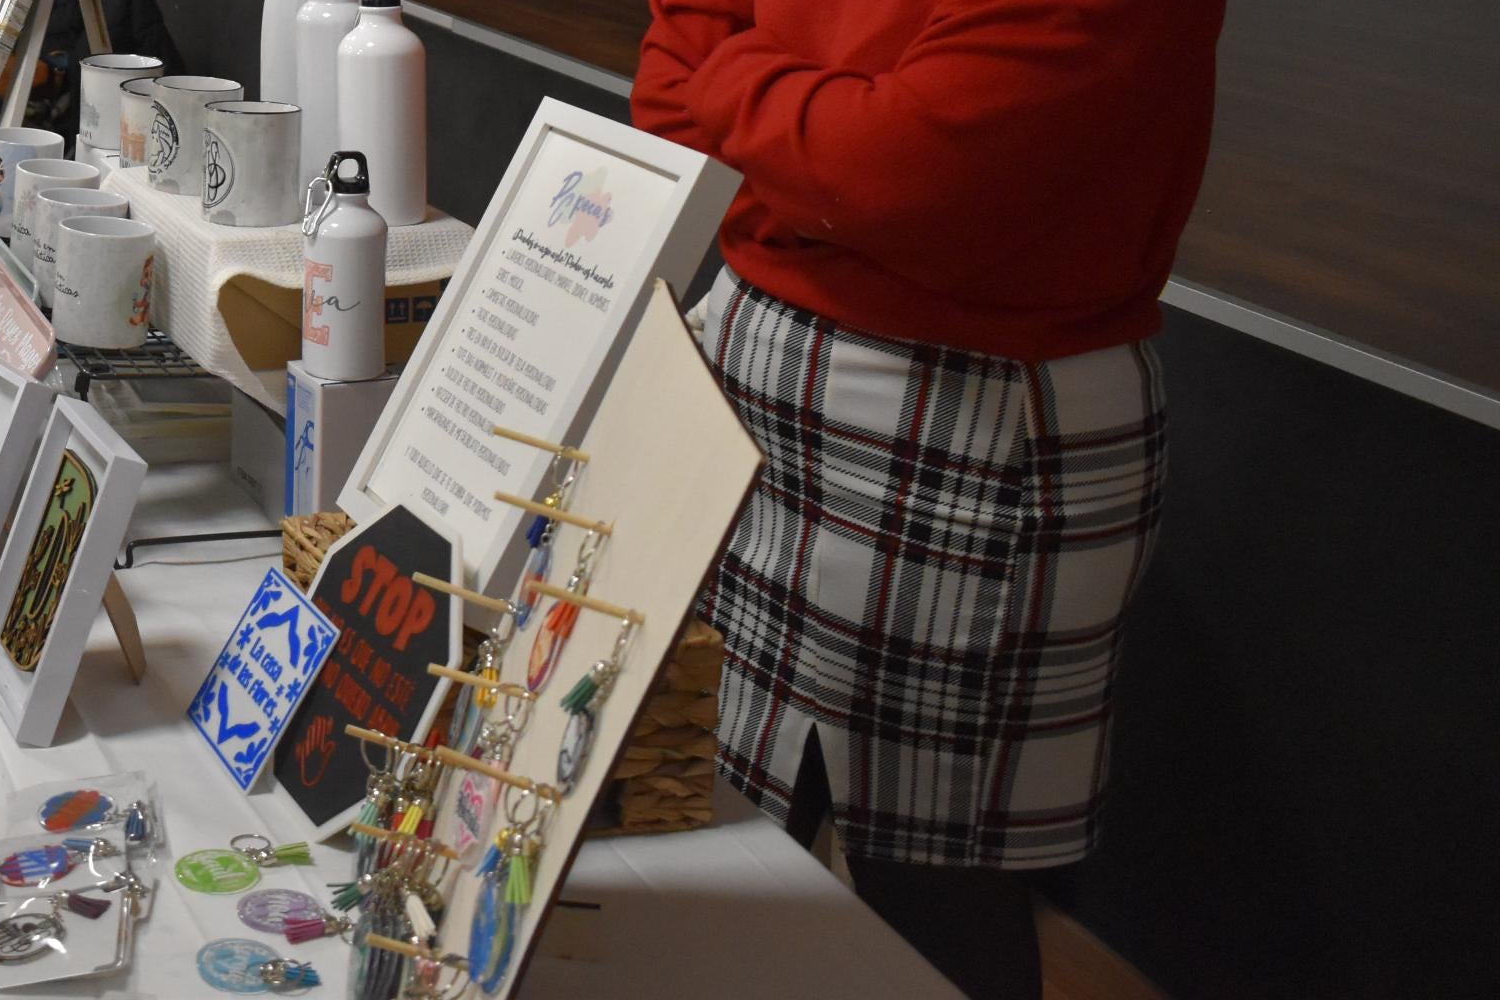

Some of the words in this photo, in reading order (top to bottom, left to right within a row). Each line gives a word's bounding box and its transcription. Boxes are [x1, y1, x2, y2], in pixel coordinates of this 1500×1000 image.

[341, 544, 437, 652] STOP
[227, 653, 242, 674] de
[237, 662, 254, 689] las
[248, 679, 278, 717] Flores
[249, 636, 265, 662] La
[260, 652, 283, 683] casa
